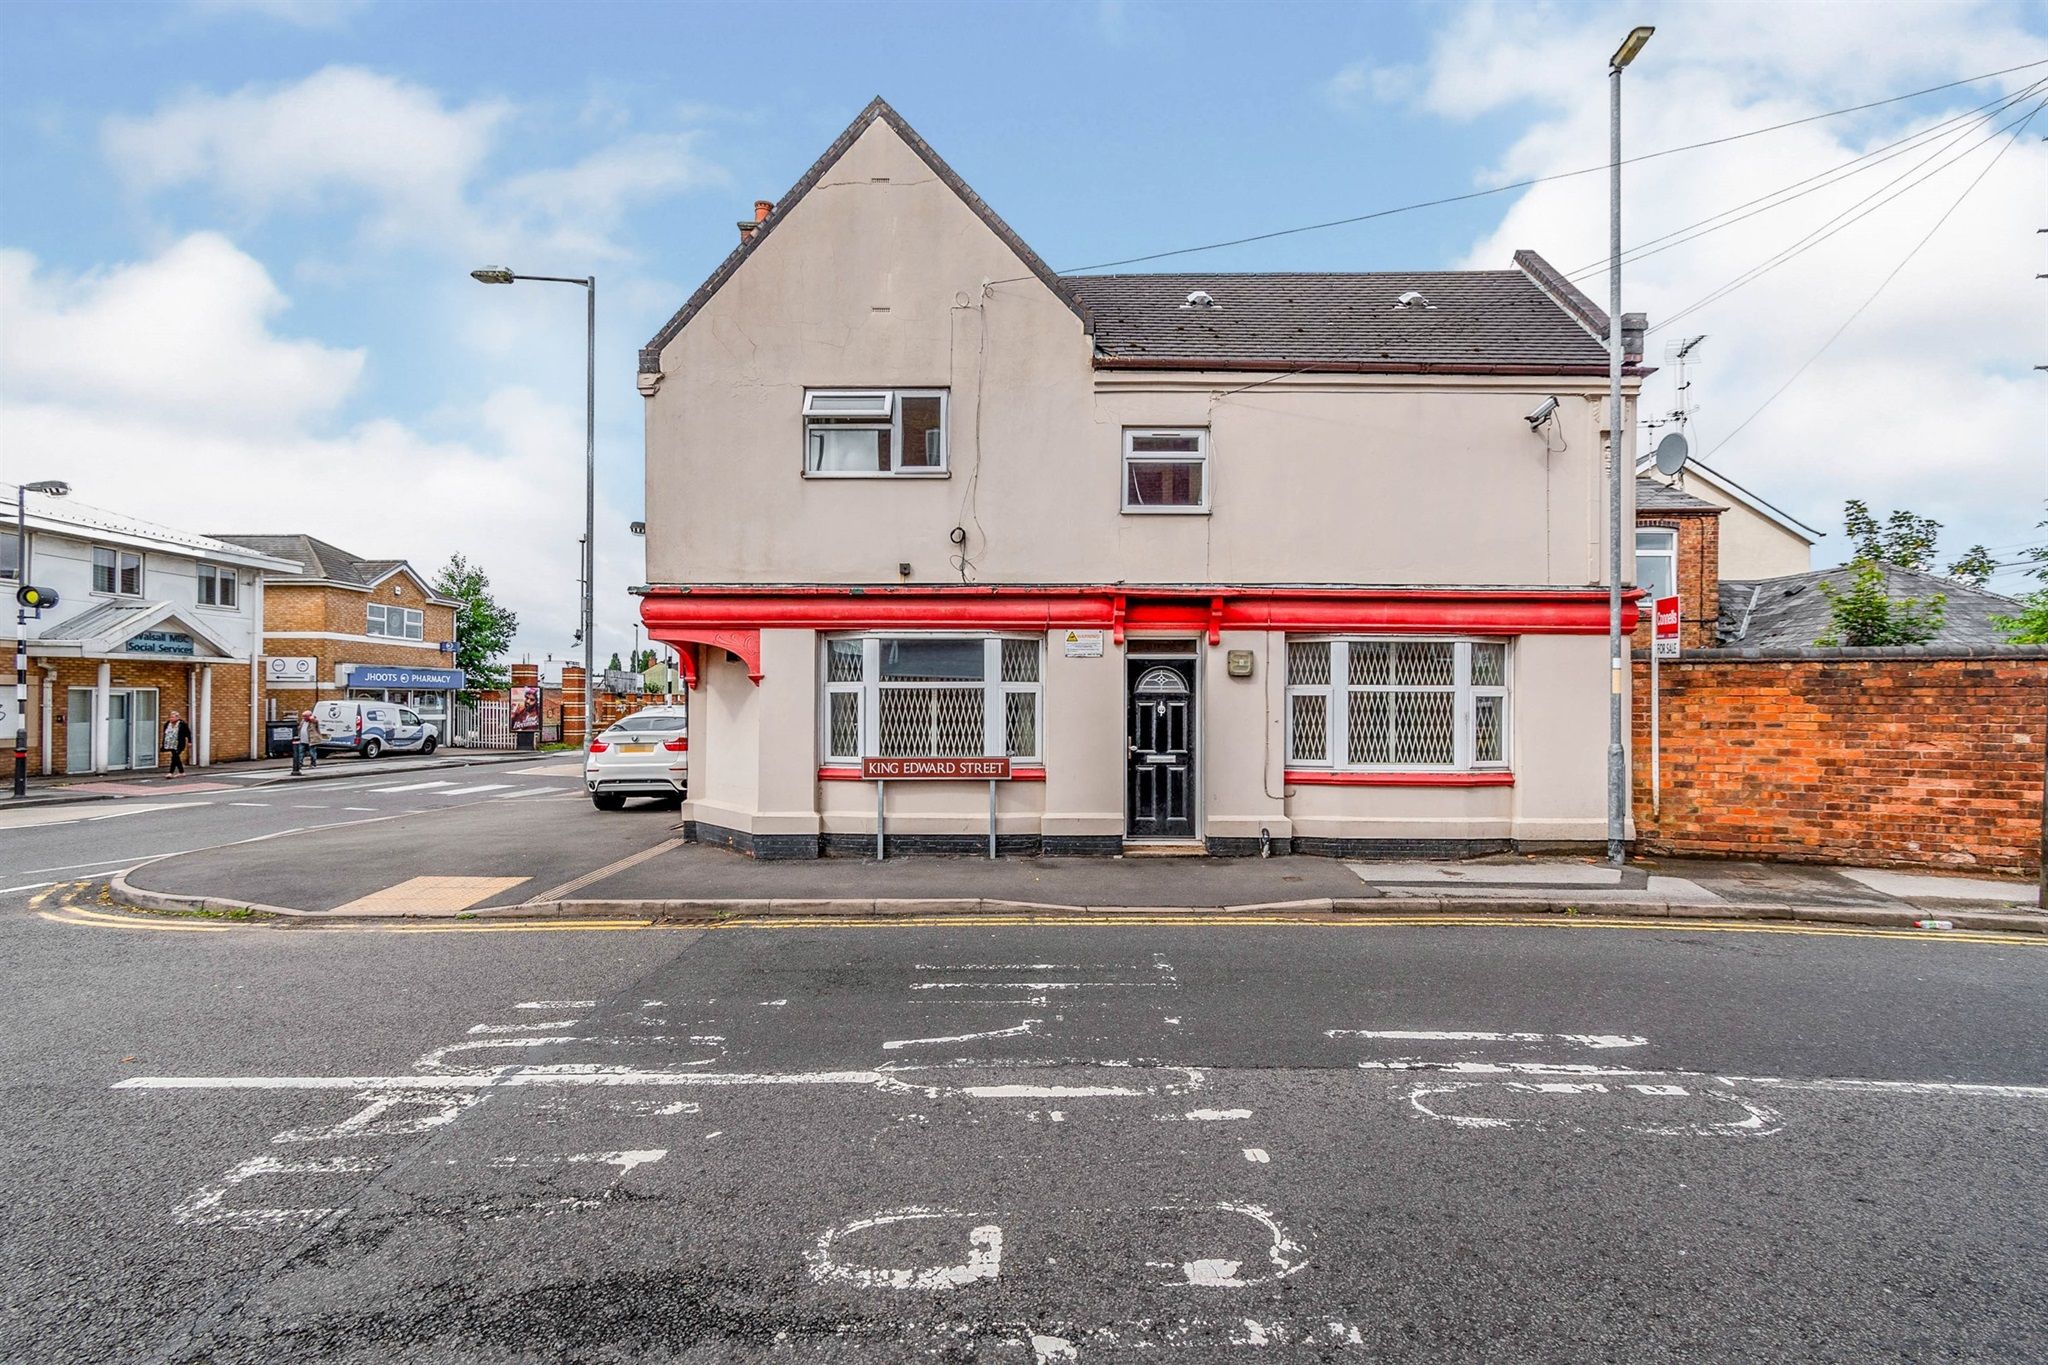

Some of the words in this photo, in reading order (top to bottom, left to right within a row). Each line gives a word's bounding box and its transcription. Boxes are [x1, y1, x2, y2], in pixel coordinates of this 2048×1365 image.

[1657, 609, 1677, 626] Connells
[128, 642, 155, 652] Social
[158, 643, 194, 654] Services
[1657, 642, 1666, 655] FOR
[1666, 642, 1677, 655] SALE
[365, 672, 398, 682] JHOOTS
[411, 674, 451, 684] PHARMACY
[868, 762, 899, 775] KING
[903, 762, 956, 775] EDWARD
[959, 762, 1005, 775] STREET
